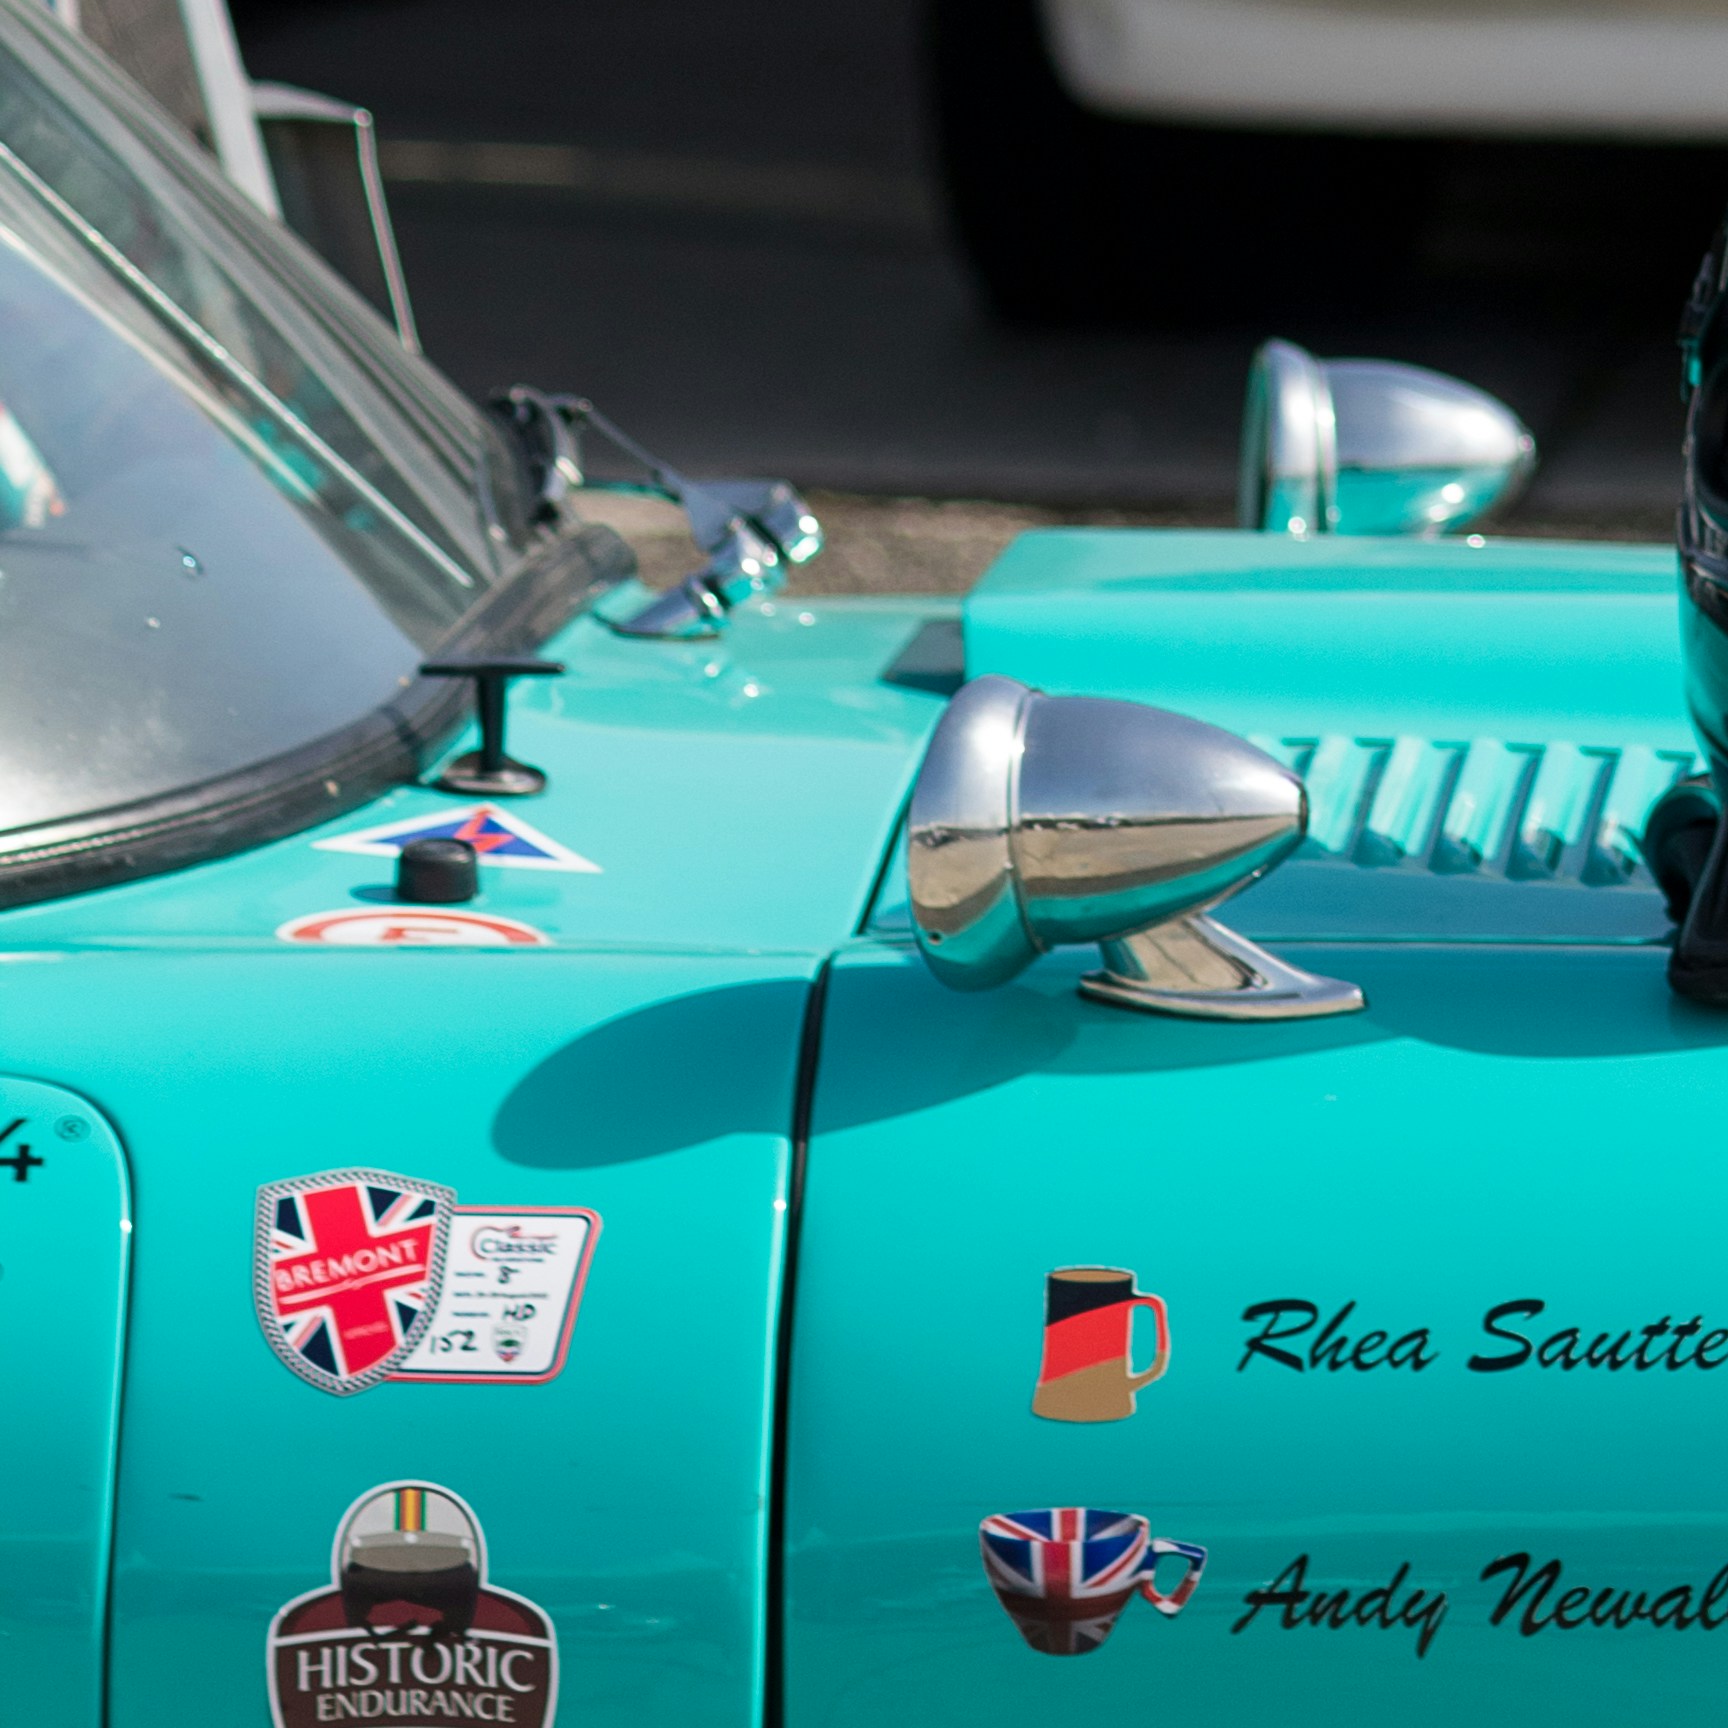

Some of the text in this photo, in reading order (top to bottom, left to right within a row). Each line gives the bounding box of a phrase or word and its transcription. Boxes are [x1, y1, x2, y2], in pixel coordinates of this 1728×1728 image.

[273, 1236, 419, 1292] BREMONT
[1236, 1299, 1438, 1373] Rhea
[1230, 1553, 1448, 1659] Andy
[297, 1641, 536, 1693] HISTORIC
[316, 1689, 517, 1723] ENDURANCE
